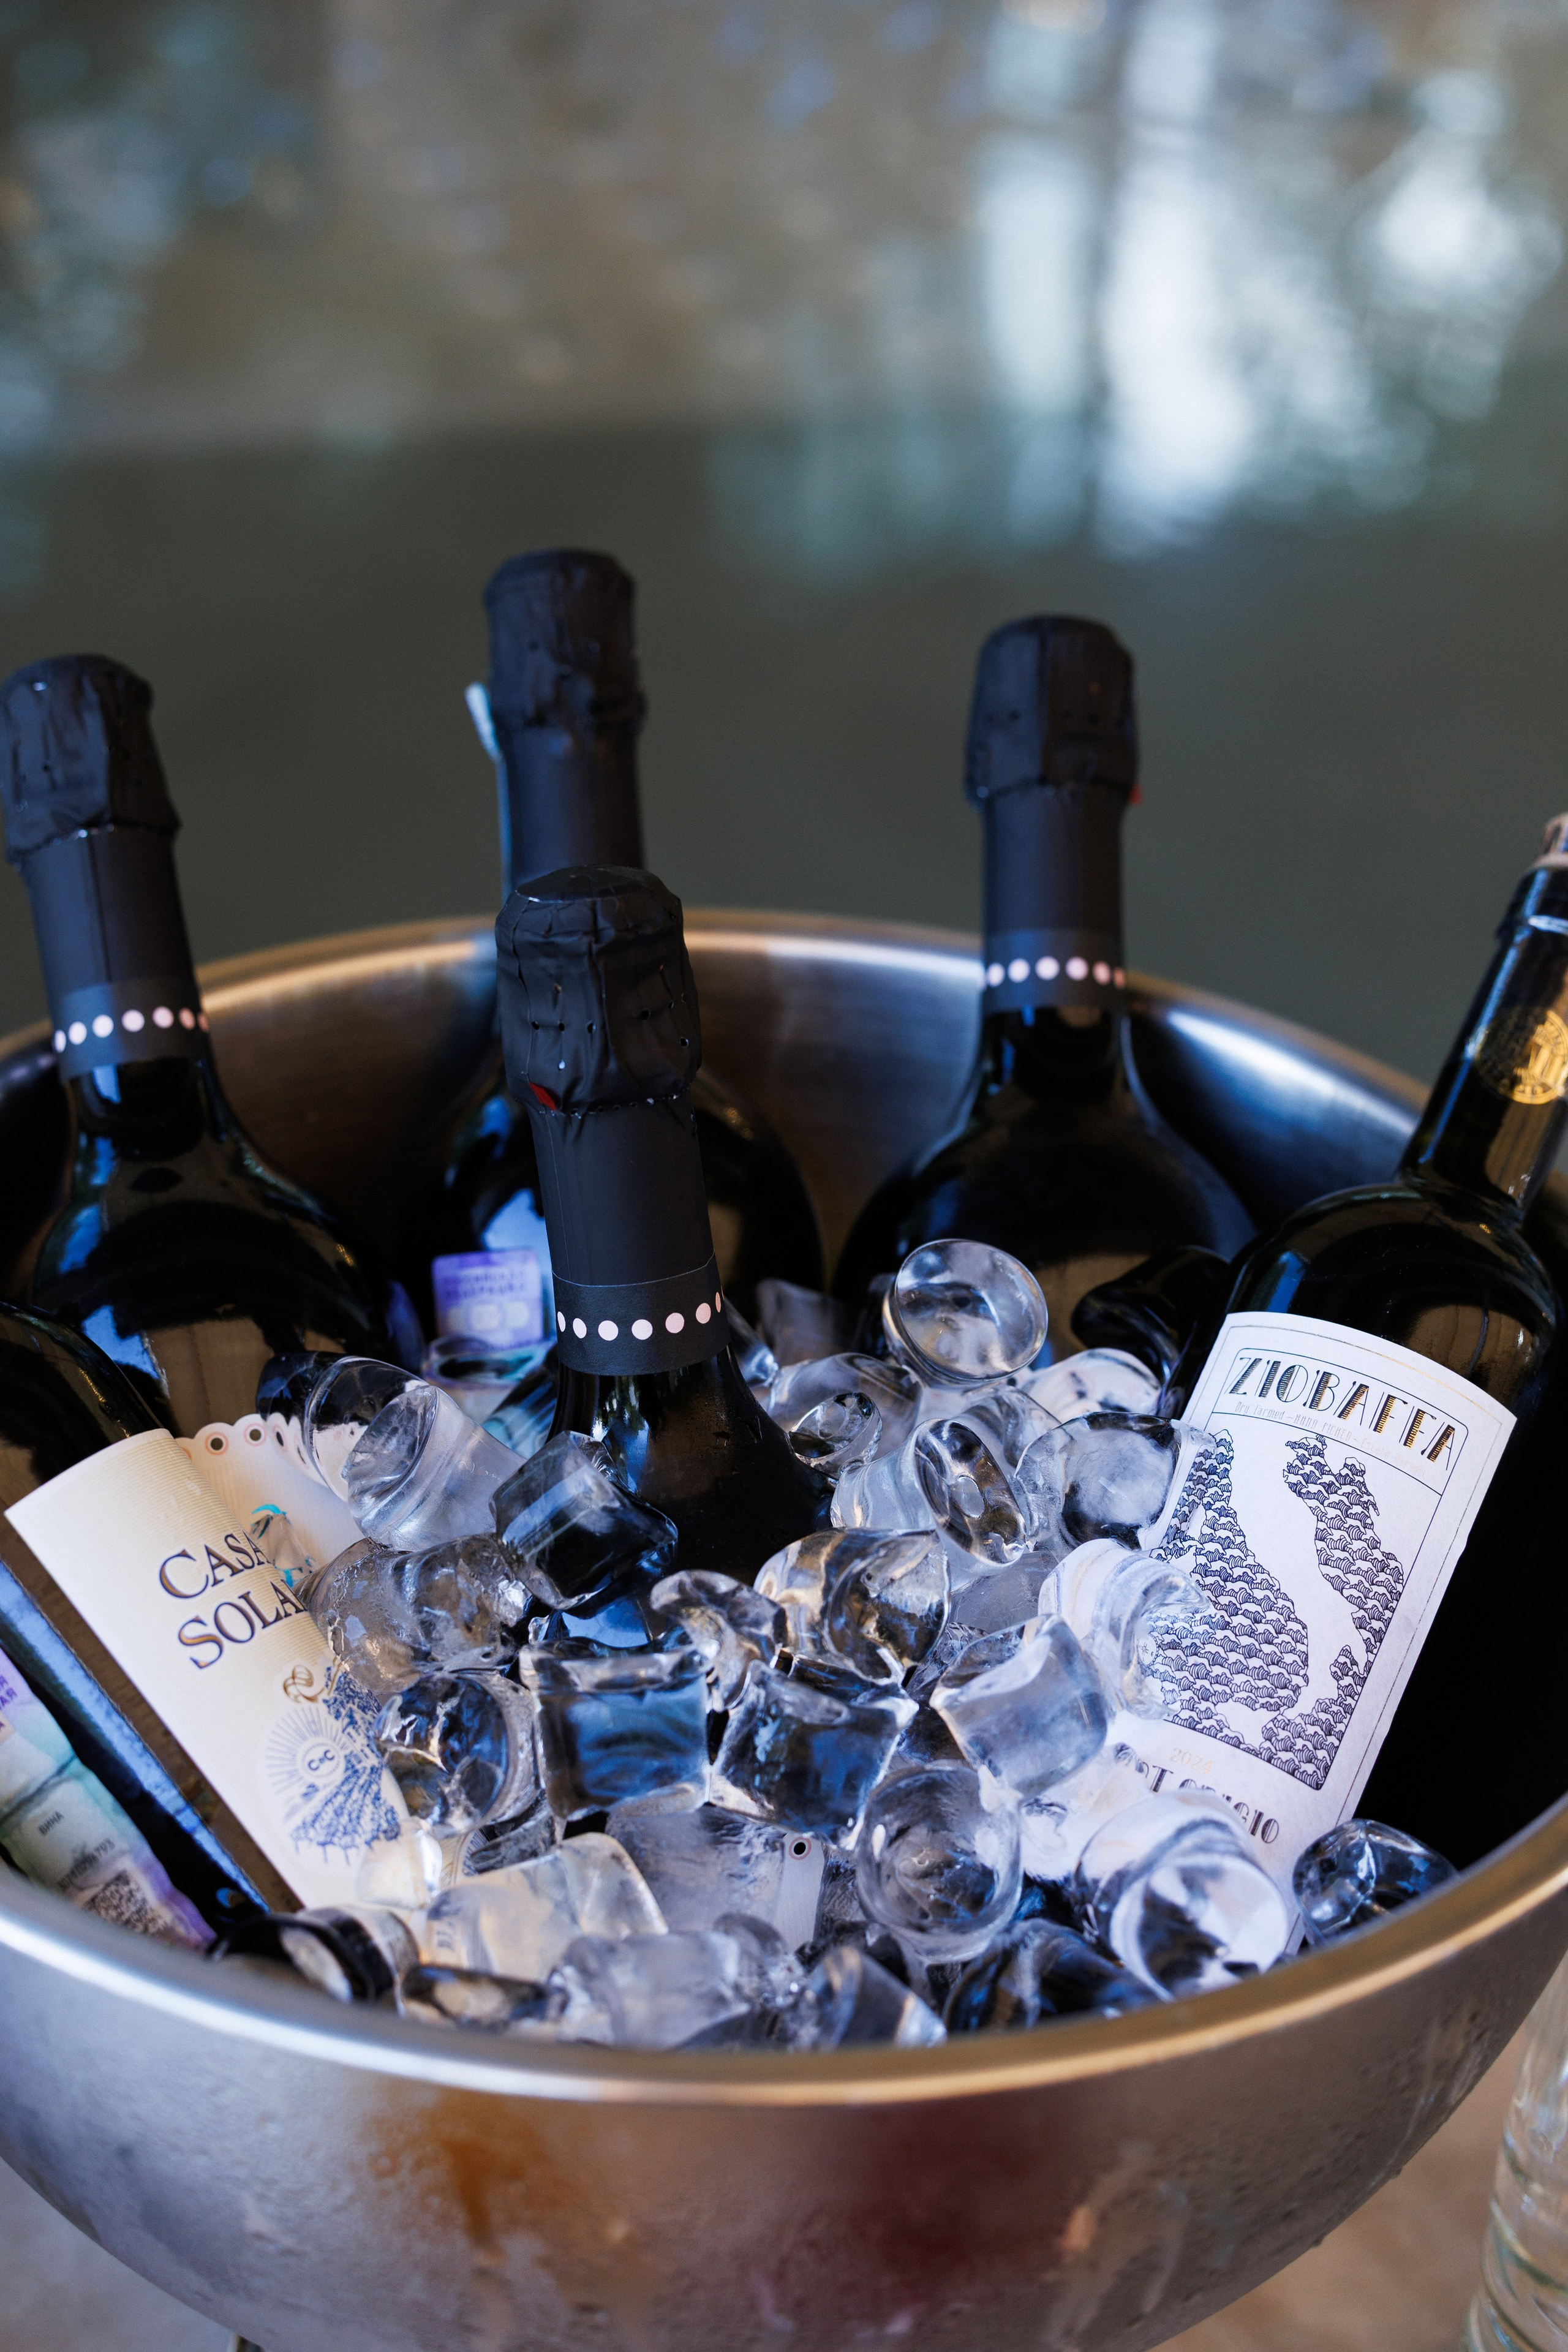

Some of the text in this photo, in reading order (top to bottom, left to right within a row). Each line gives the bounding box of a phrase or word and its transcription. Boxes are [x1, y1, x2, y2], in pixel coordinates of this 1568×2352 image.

[1225, 1357, 1456, 1471] ZIOBAFFA
[1235, 1401, 1251, 1415] Dry
[1293, 1414, 1318, 1430] HAND
[159, 1530, 274, 1599] CASA
